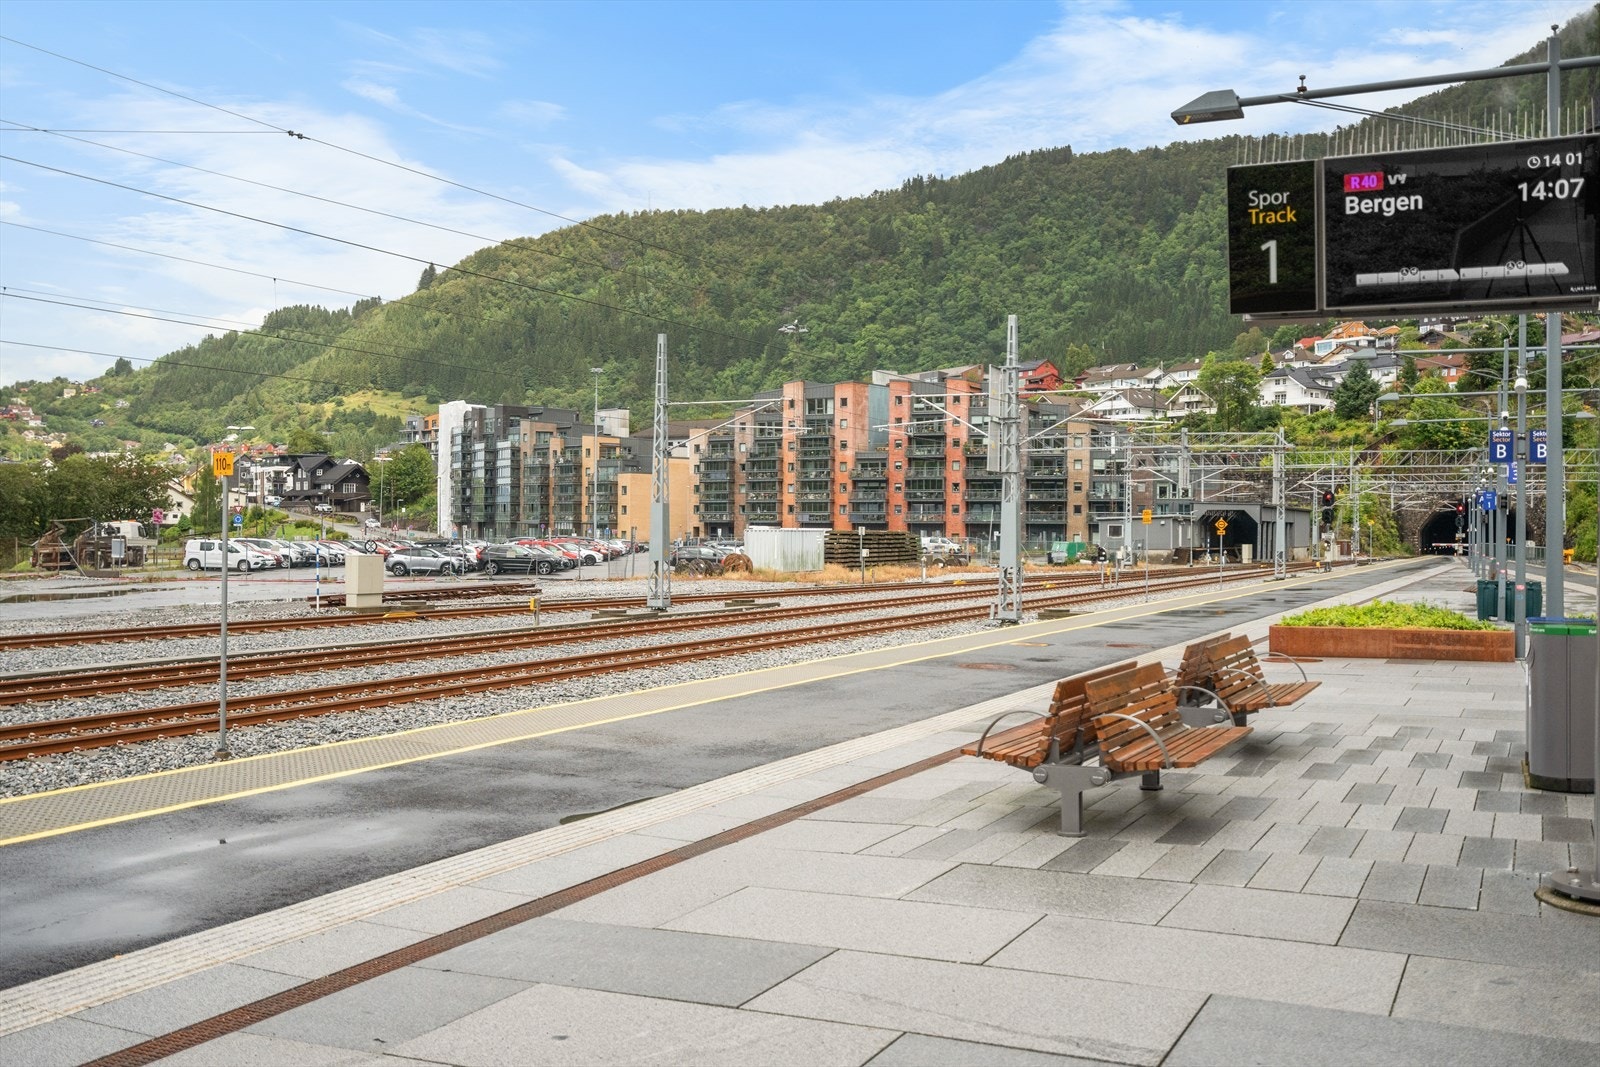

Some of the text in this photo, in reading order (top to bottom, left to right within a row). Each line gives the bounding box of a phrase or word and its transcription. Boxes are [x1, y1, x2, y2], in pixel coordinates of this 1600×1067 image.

[1543, 152, 1582, 167] 14 01
[1350, 174, 1378, 189] R 40
[1518, 178, 1584, 201] 14:07
[1248, 190, 1290, 209] Spor
[1345, 194, 1423, 217] Bergen
[1247, 206, 1297, 225] Track
[1260, 240, 1277, 284] 1
[1496, 444, 1507, 458] B
[1537, 444, 1547, 458] B
